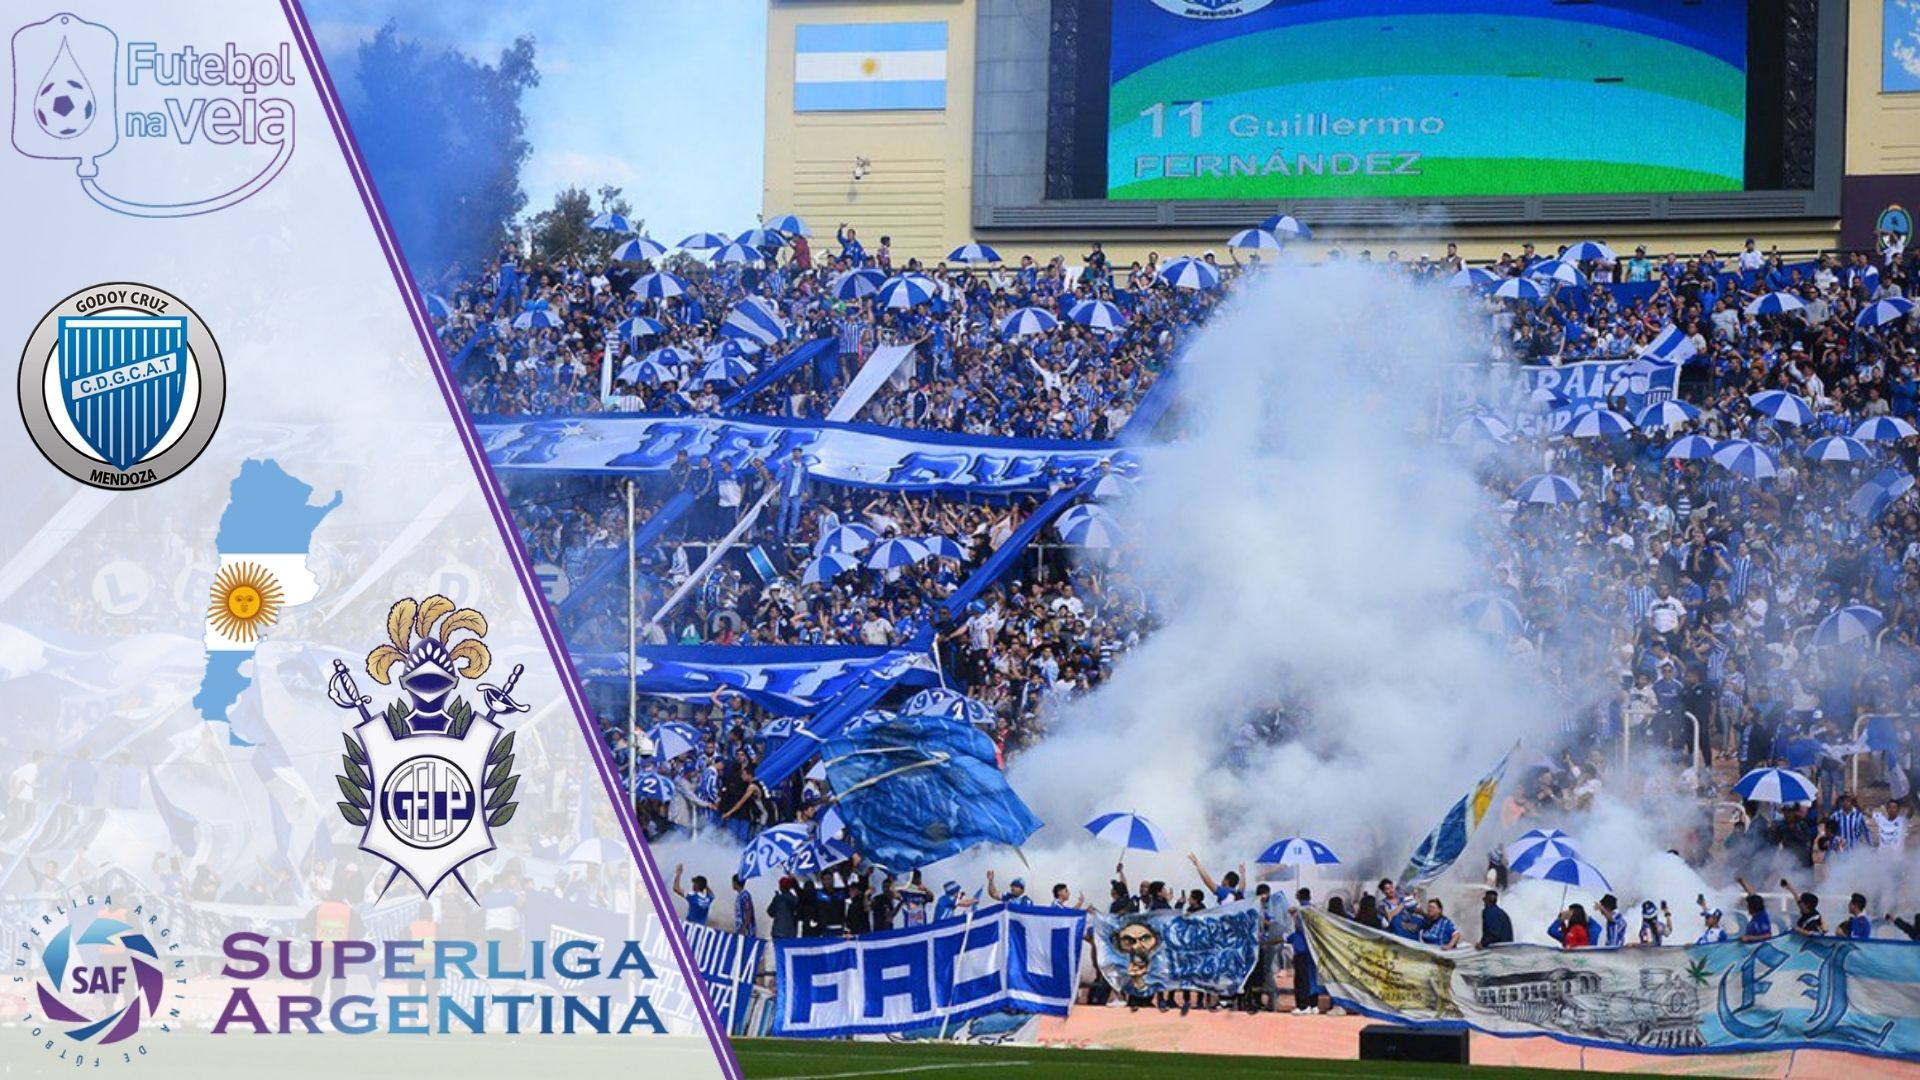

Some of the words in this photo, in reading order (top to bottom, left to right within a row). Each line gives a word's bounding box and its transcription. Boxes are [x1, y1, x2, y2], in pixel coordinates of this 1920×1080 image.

[1140, 101, 1204, 138] 11
[1228, 113, 1446, 138] Guillermo
[1134, 148, 1424, 178] FERNÁNDEZ
[790, 918, 1073, 1024] FACU
